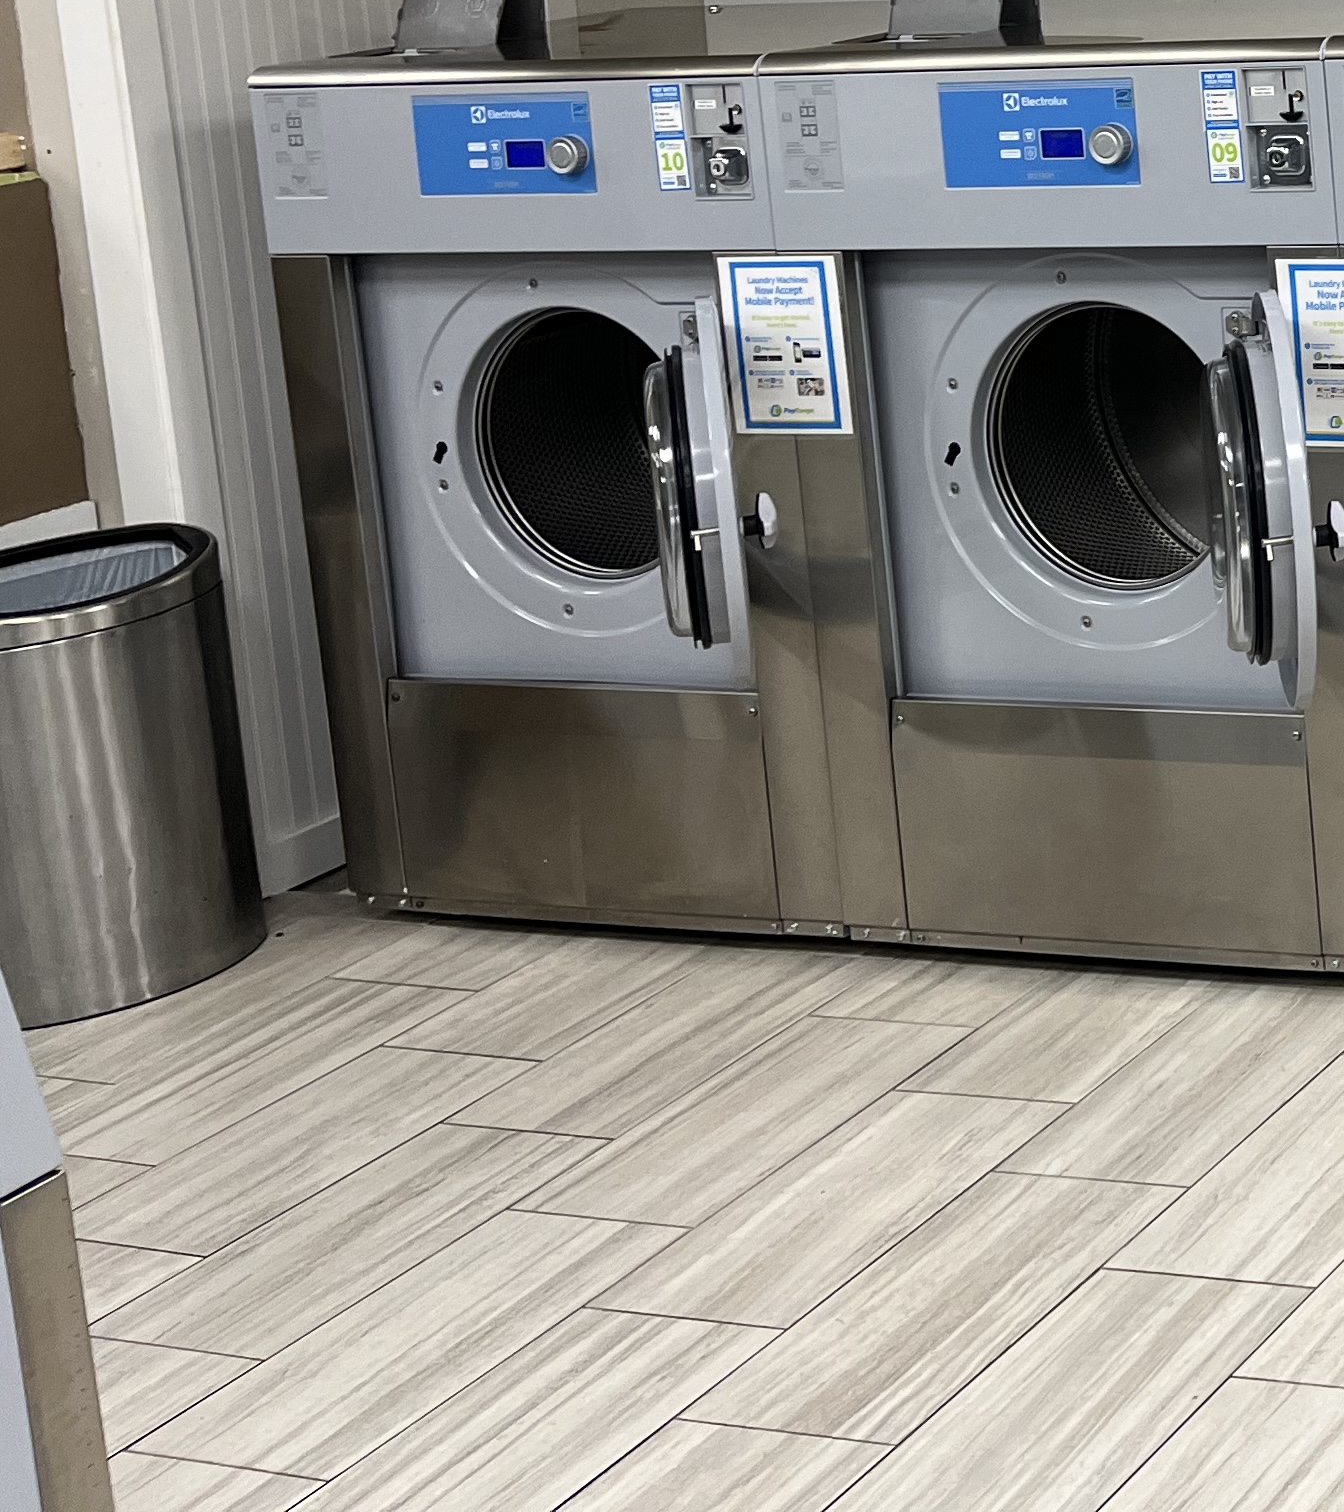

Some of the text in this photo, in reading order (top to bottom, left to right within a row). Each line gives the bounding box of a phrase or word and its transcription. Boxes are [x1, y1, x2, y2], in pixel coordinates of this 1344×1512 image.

[1021, 96, 1068, 107] Electrolux
[488, 109, 530, 120] Electrolux
[1212, 142, 1238, 163] 09
[661, 152, 684, 171] 10
[747, 276, 808, 286] Laundry Machines
[1309, 280, 1341, 289] Laundry
[754, 286, 802, 297] Now Accept
[1317, 290, 1339, 299] Now
[745, 296, 815, 307] Mobile Payment!
[1305, 301, 1337, 311] Mobile
